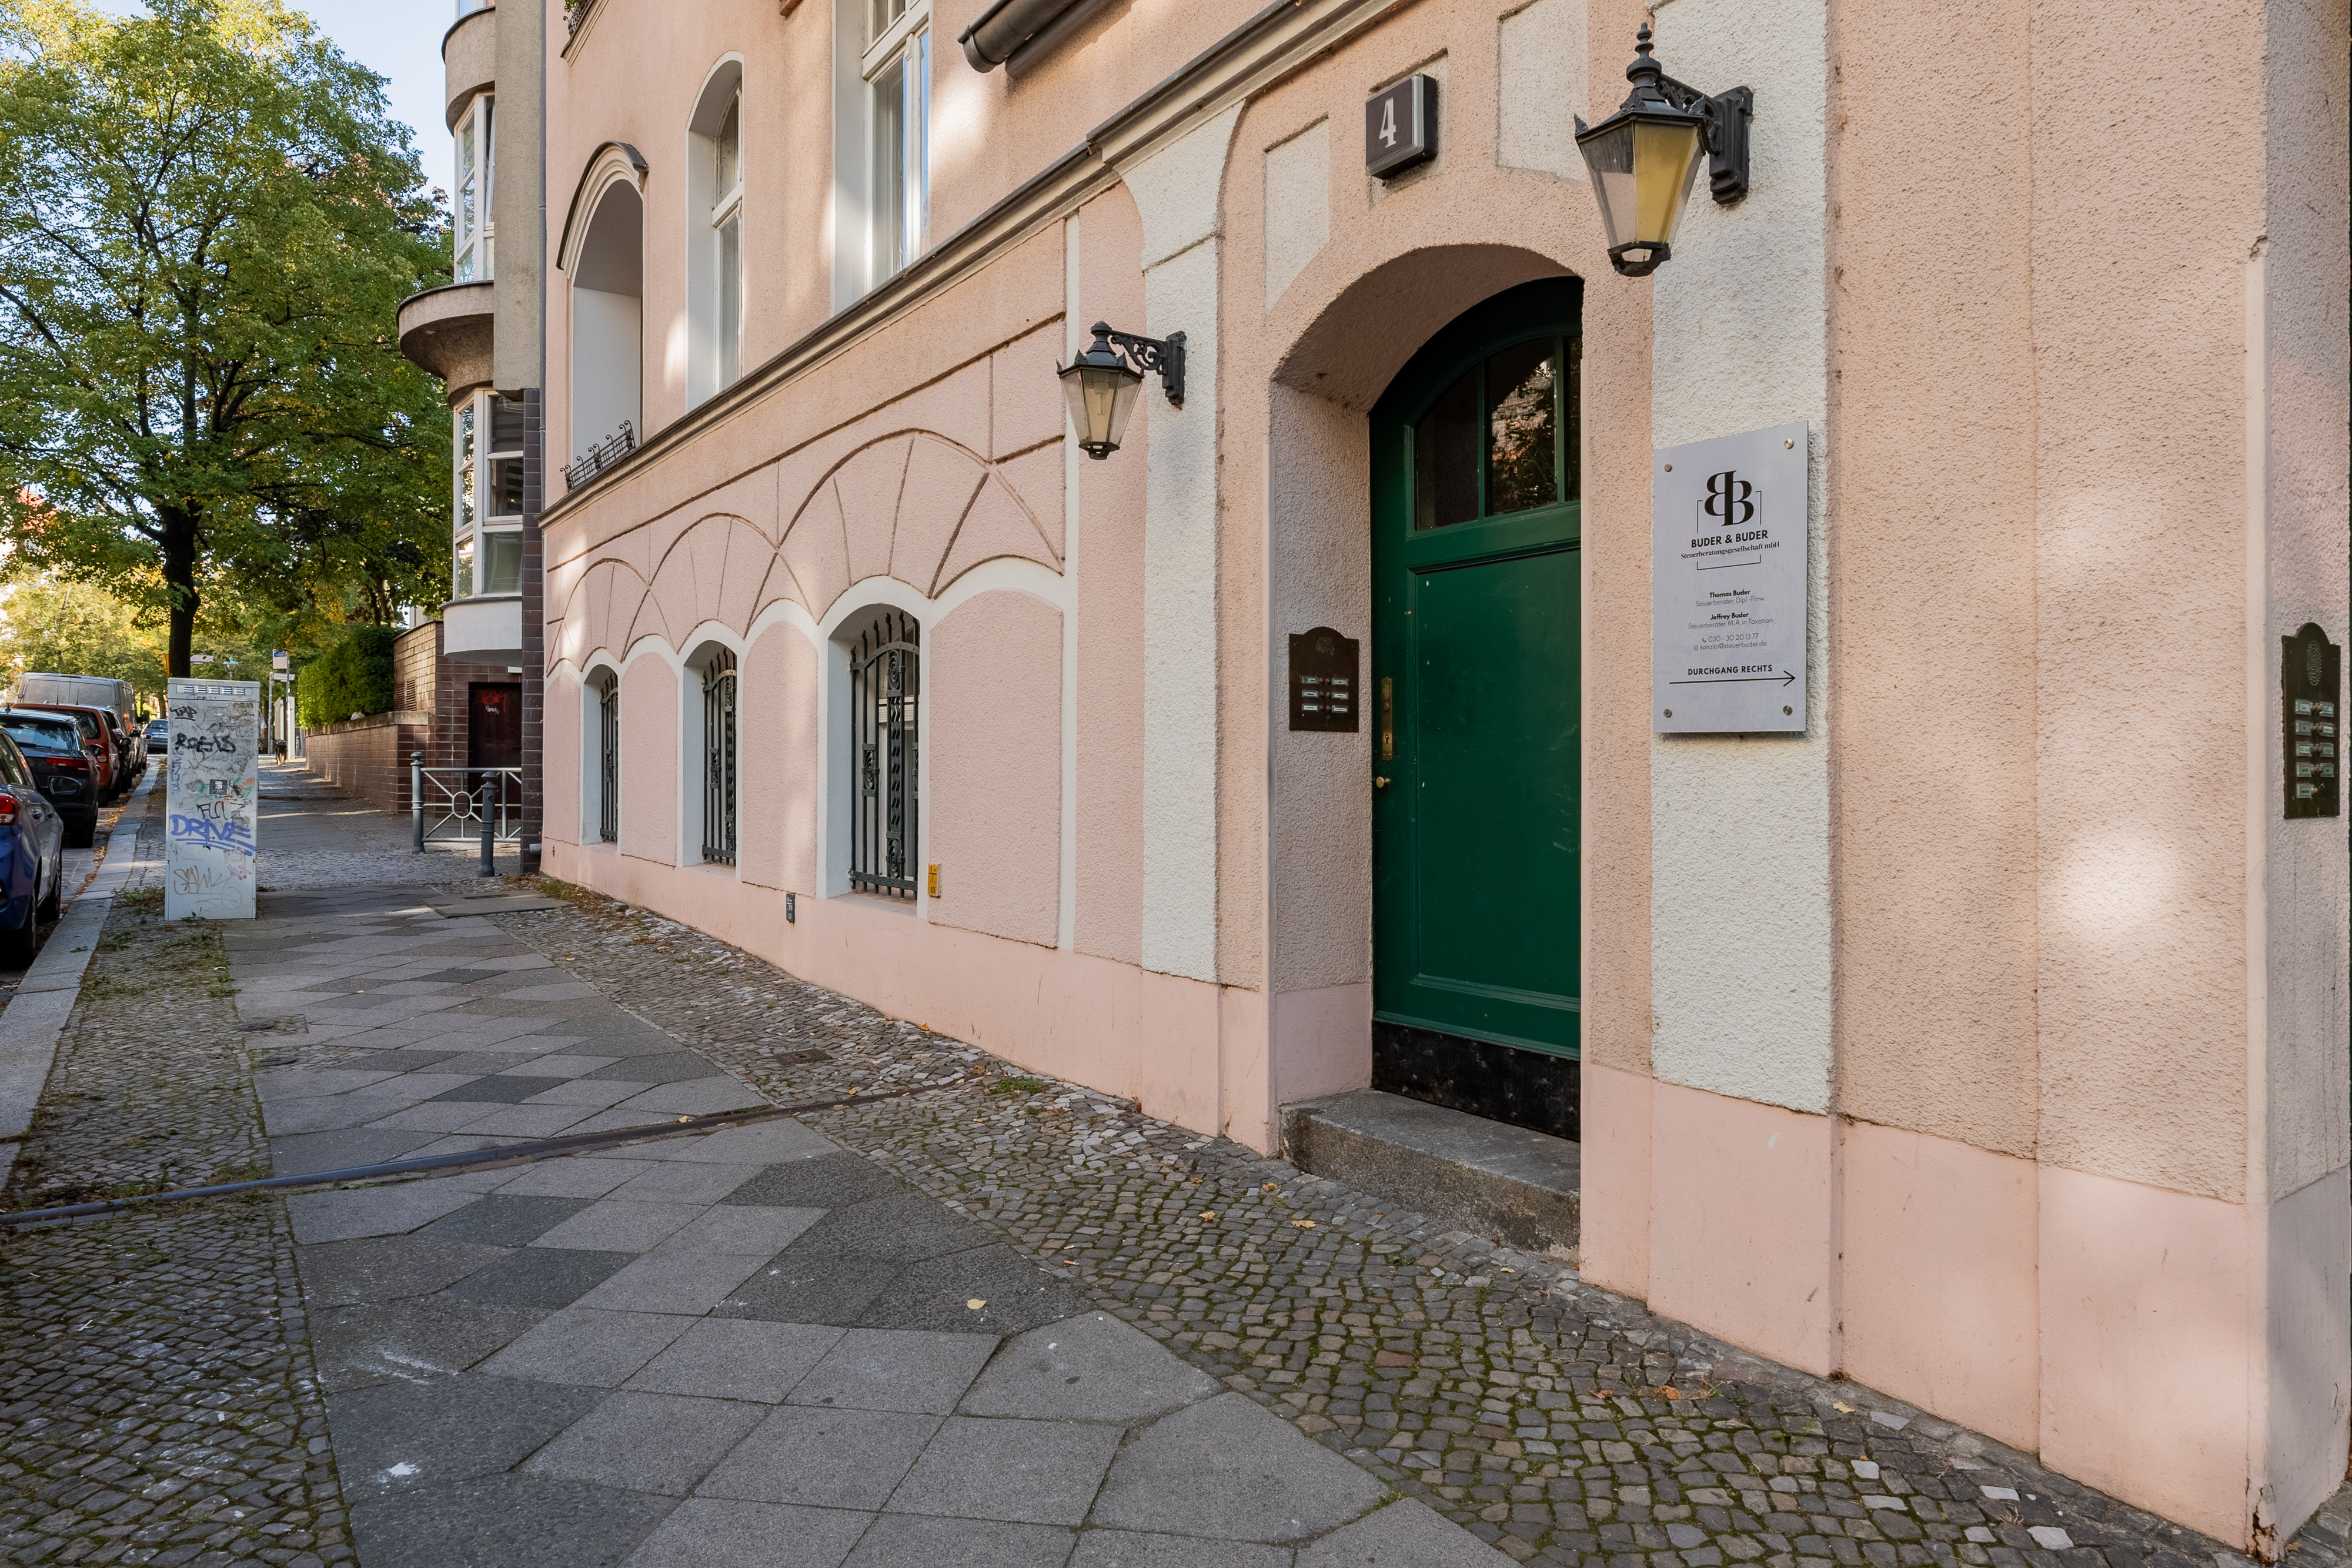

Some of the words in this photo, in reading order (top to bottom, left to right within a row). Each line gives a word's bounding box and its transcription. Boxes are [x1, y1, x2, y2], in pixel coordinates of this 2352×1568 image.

[1379, 97, 1396, 149] 4
[1691, 536, 1722, 549] BUDER
[1725, 534, 1733, 544] &
[1735, 530, 1769, 543] BUDER
[1681, 543, 1763, 559] Steuerberatungsgesellschaft
[1700, 640, 1768, 650] kanzlei@steuerbuder.de
[1688, 666, 1739, 676] DURCHGANG
[1741, 664, 1773, 673] RECHTS
